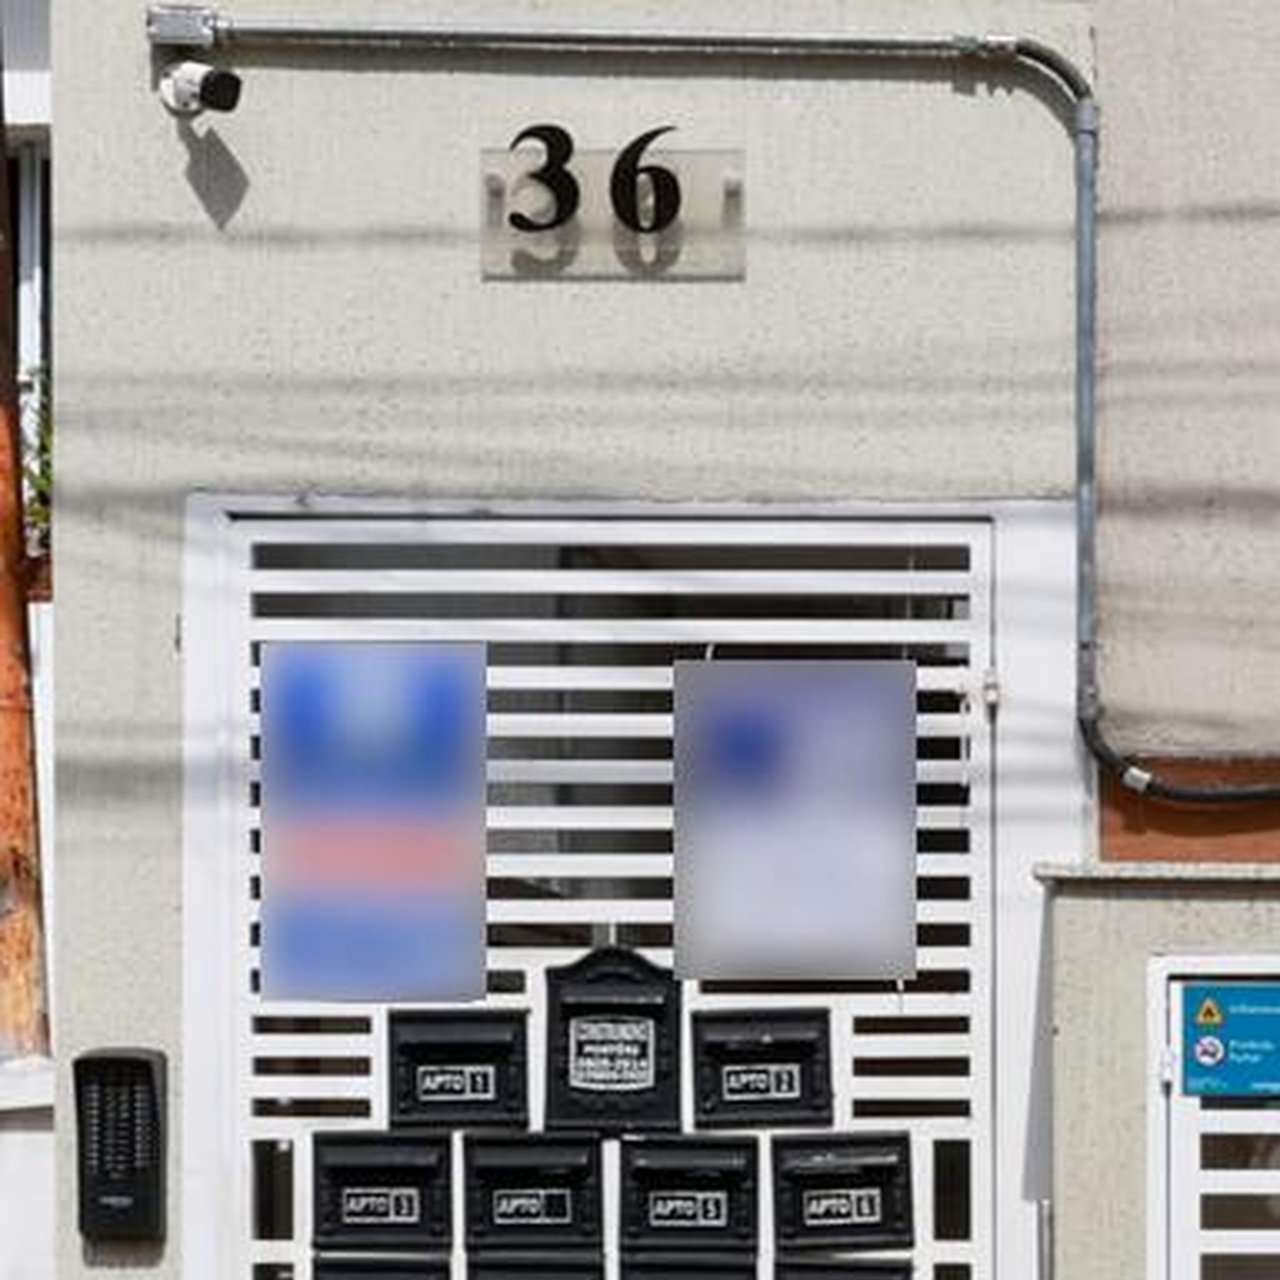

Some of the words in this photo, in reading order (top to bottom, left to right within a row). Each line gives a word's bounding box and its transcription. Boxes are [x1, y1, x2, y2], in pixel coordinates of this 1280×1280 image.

[508, 124, 679, 233] 36
[422, 1074, 462, 1090] APTO
[728, 1074, 767, 1089] APTO
[346, 1195, 387, 1211] APTO
[498, 1198, 540, 1214] APTO
[654, 1200, 694, 1216] APTO
[808, 1198, 849, 1215] APTO
